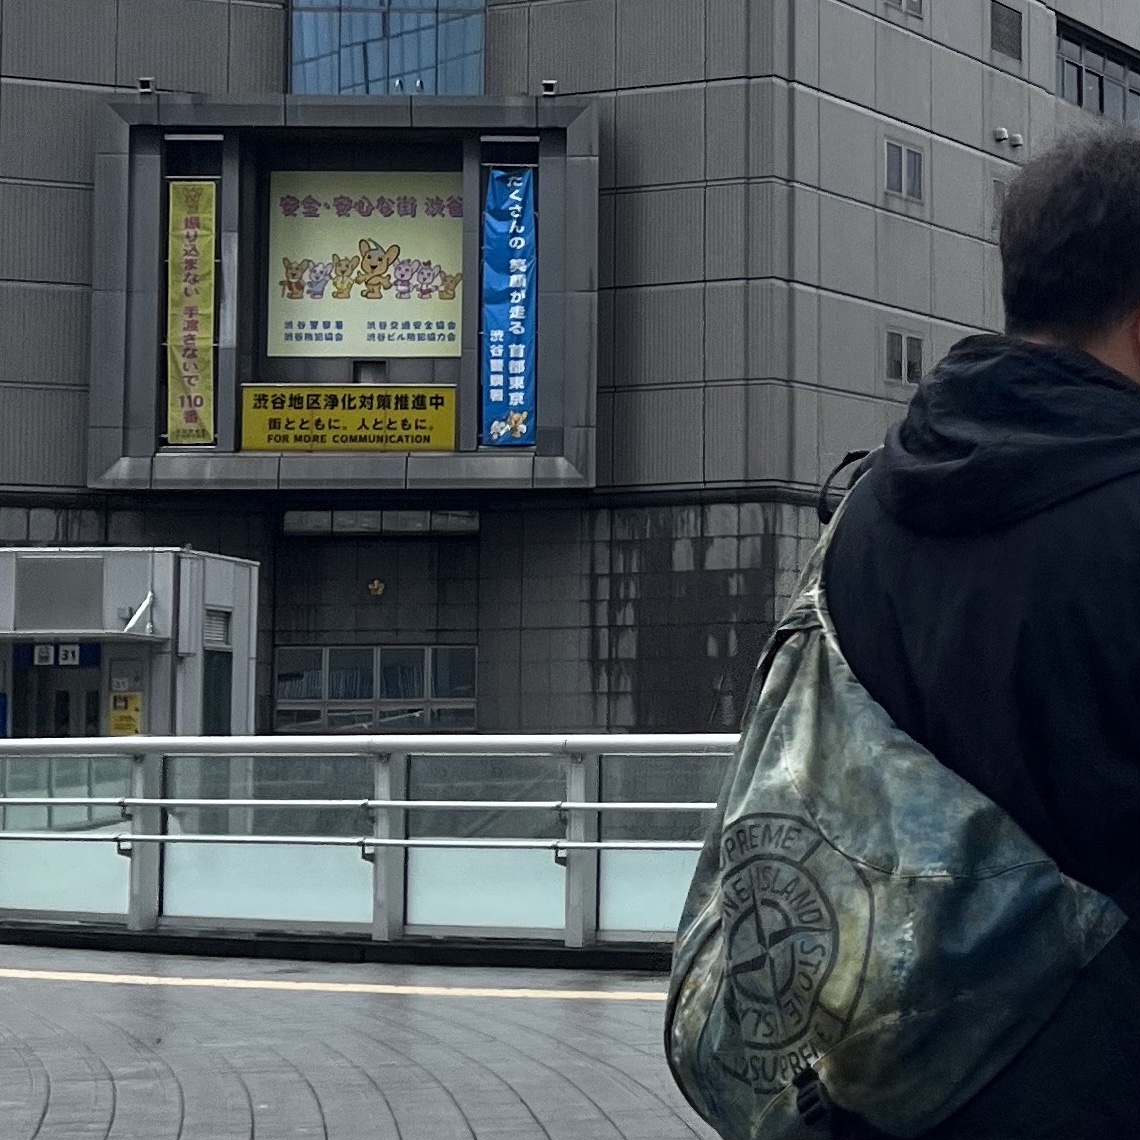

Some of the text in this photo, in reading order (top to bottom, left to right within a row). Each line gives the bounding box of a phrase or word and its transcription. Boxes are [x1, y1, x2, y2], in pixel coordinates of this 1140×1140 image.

[507, 176, 526, 250] たくさんの
[489, 329, 504, 402] 渋谷警察署
[508, 343, 526, 406] 首都東京
[252, 393, 445, 410] 渋谷地区浄化対策推進中
[268, 418, 434, 431] 街とともに。 人とともに。
[267, 434, 431, 444] FOR MORE COMMUNICATION
[61, 650, 76, 661] 31
